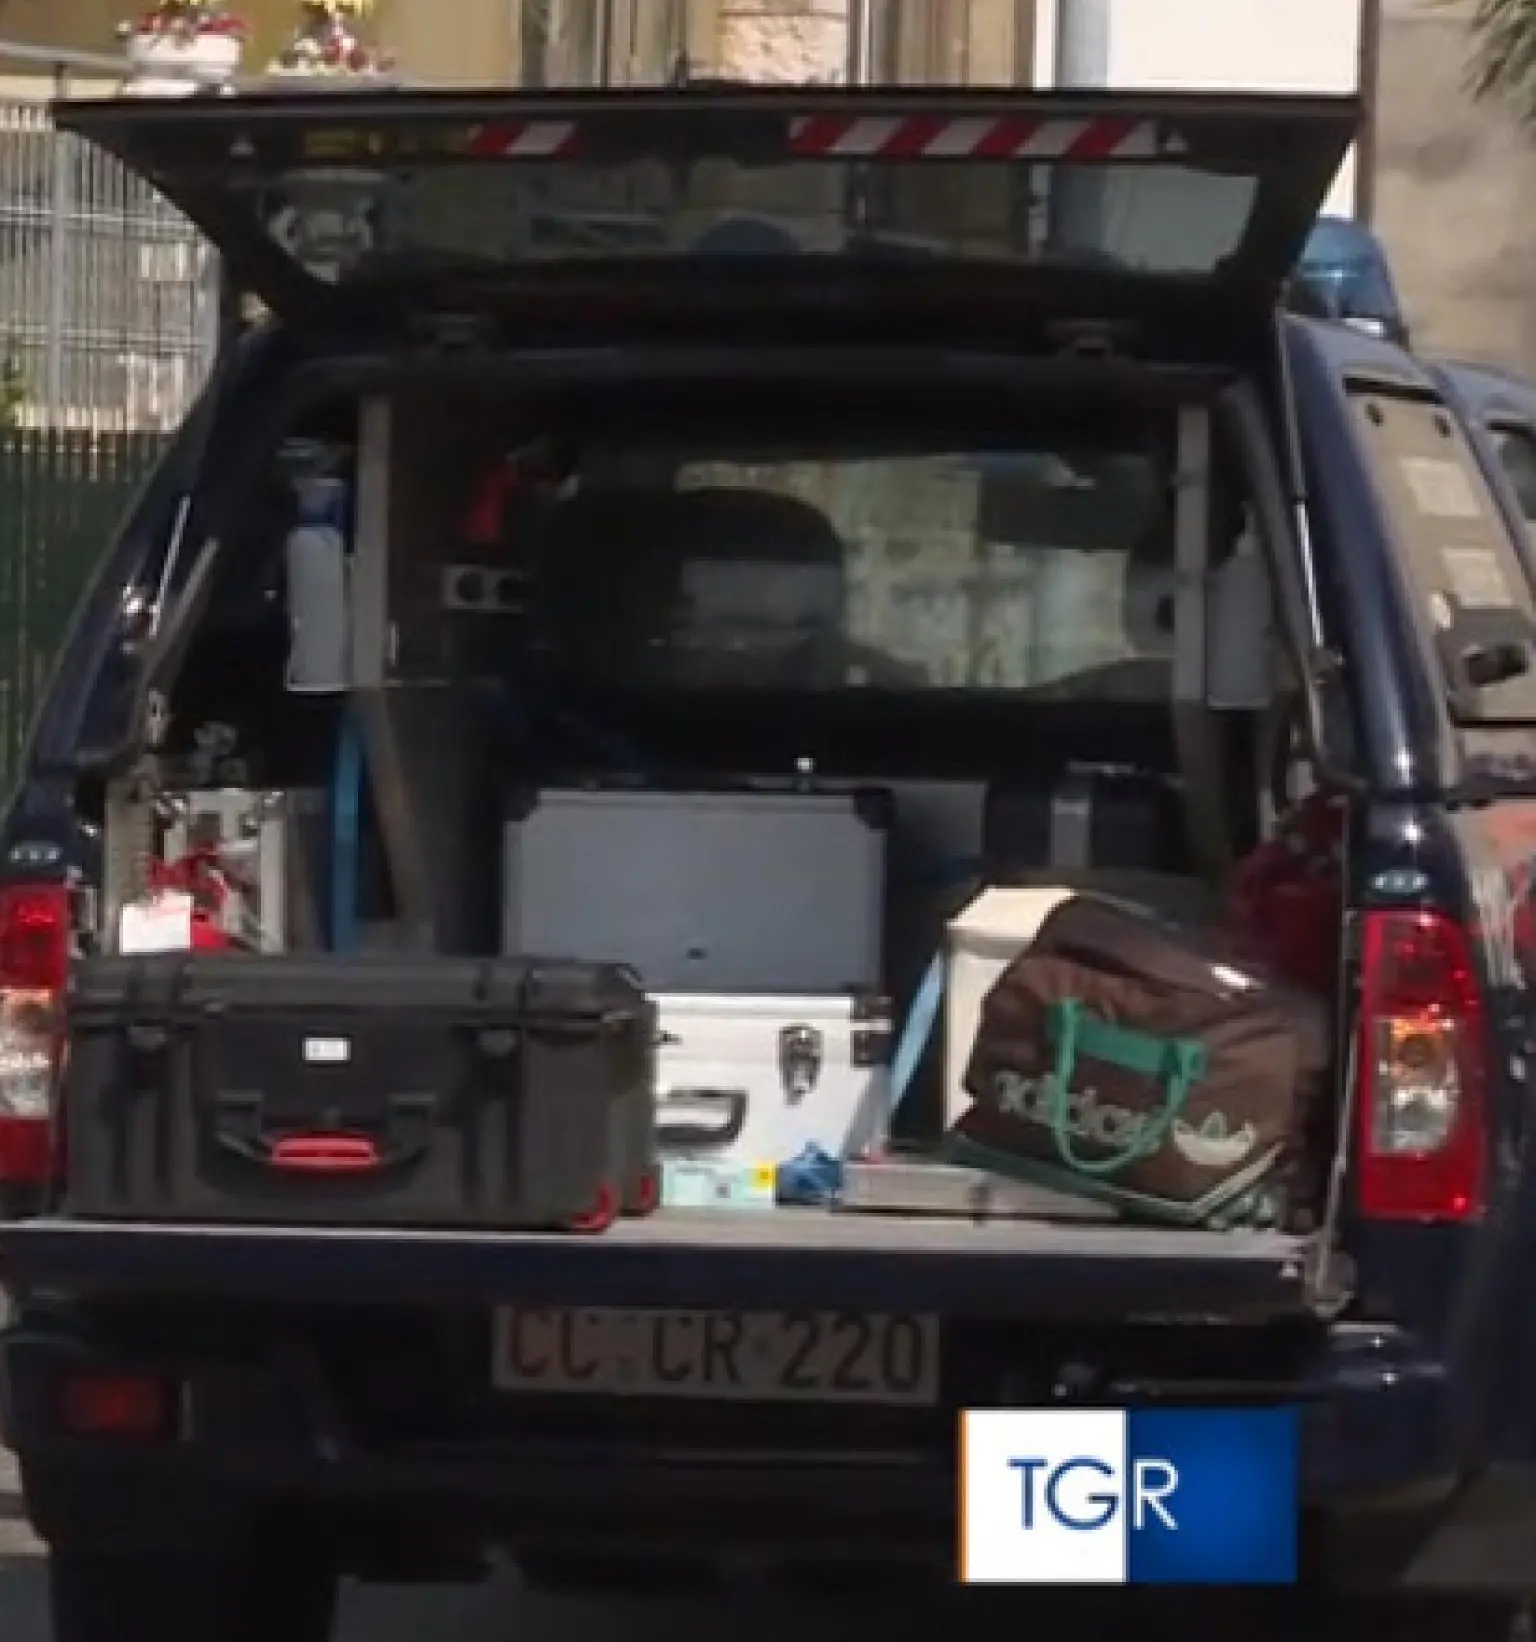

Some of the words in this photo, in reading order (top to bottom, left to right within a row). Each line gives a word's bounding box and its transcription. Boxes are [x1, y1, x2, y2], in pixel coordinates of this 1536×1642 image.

[508, 1306, 598, 1380] CC
[652, 1312, 743, 1383] CR
[778, 1311, 924, 1391] 220
